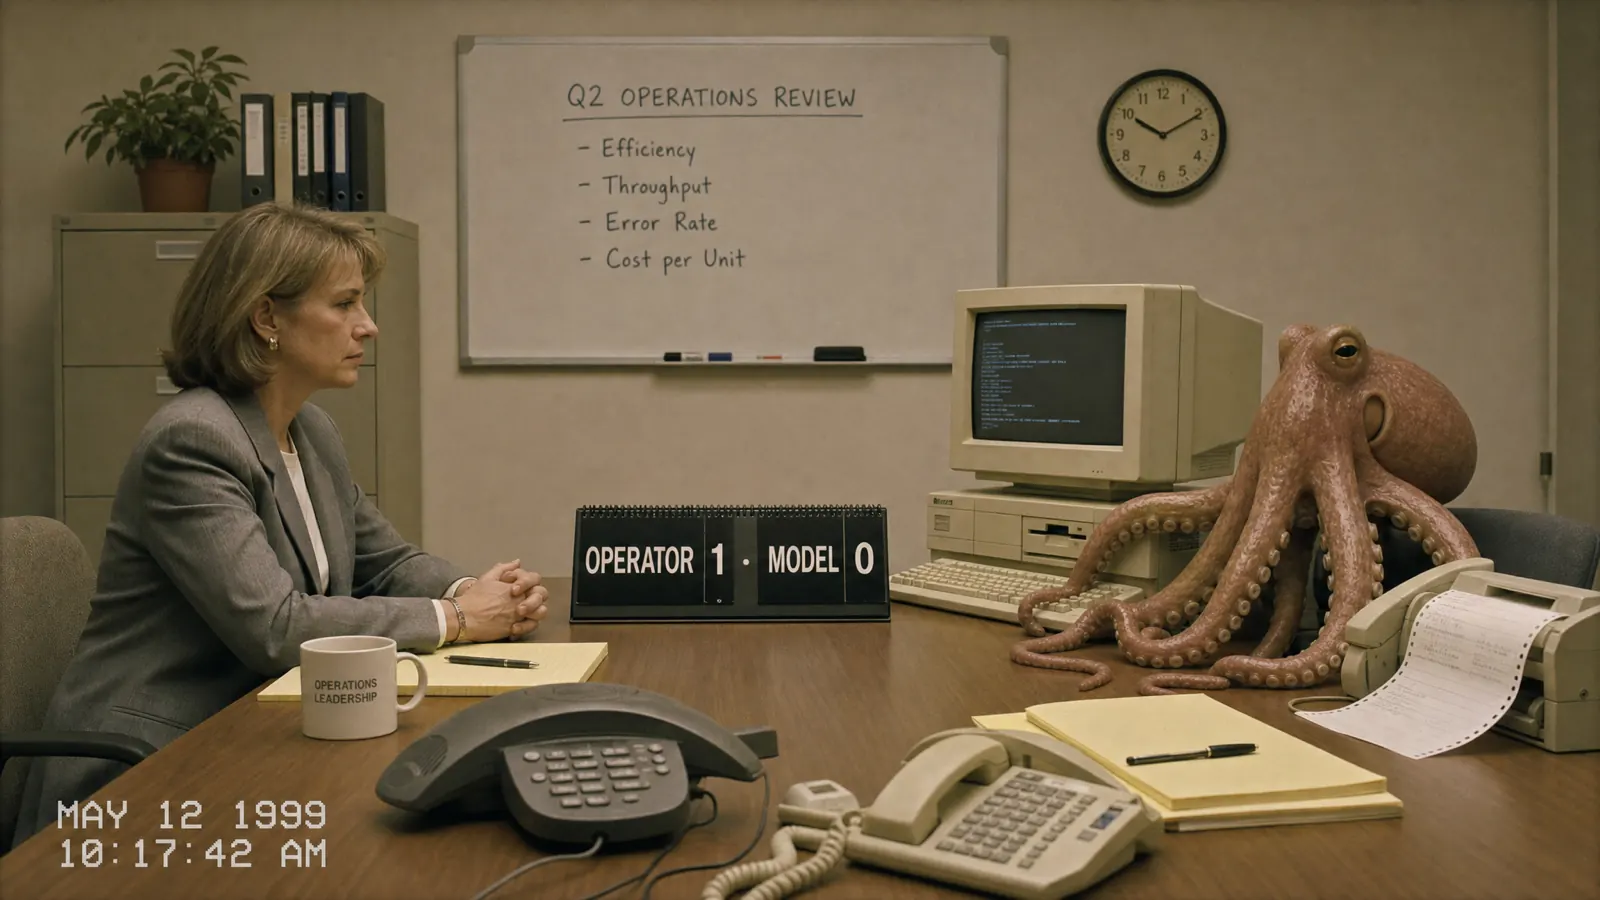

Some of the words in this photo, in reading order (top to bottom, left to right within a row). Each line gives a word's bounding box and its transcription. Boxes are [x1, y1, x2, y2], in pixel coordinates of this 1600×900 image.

[568, 84, 603, 108] Q2
[622, 87, 757, 107] OPERATIONS
[775, 86, 855, 107] REVIEW
[1138, 93, 1148, 105] 11
[1156, 88, 1170, 100] 12
[1181, 94, 1186, 105] 1
[1122, 108, 1134, 120] 10
[1116, 129, 1125, 141] 9
[1200, 129, 1209, 141] 3
[602, 138, 696, 167] Efficiency
[1122, 150, 1130, 162] 8
[1193, 150, 1202, 162] 4
[1138, 165, 1147, 177] 7
[1157, 171, 1166, 181] 6
[1178, 165, 1187, 177] 5
[603, 175, 711, 204] Throughput
[606, 211, 660, 232] Error
[676, 212, 717, 231] Rate
[607, 248, 651, 268] Cost
[664, 255, 692, 276] per
[705, 249, 745, 267] Unit
[586, 546, 693, 574] OPERATOR
[711, 543, 723, 575] 1
[769, 546, 839, 573] MODEL
[855, 542, 873, 574] 0
[314, 678, 377, 690] OPERATIONS
[314, 692, 377, 704] LEADERSHIP
